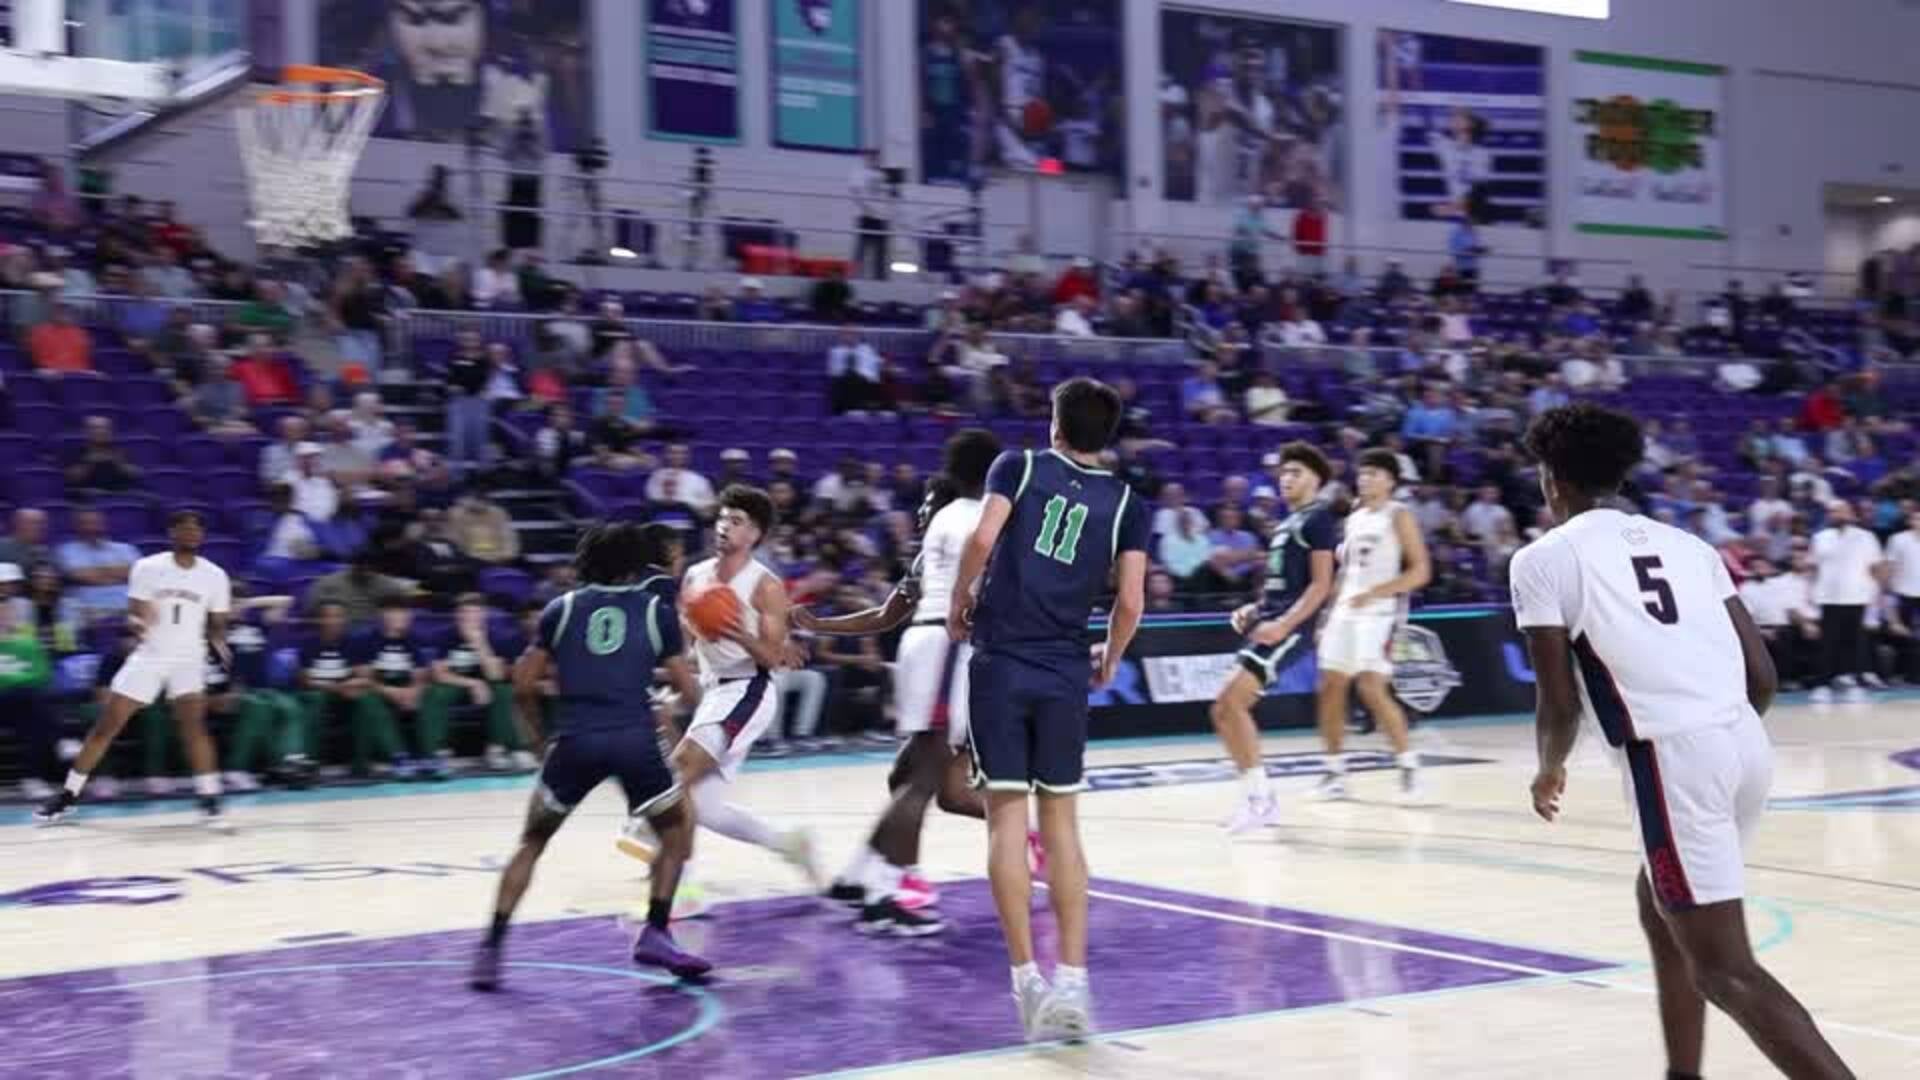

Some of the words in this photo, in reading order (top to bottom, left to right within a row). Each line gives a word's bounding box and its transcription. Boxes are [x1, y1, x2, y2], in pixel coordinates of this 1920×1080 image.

[1034, 495, 1089, 565] 11
[172, 603, 181, 625] 1
[1631, 555, 1679, 624] 5
[586, 606, 627, 655] 0
